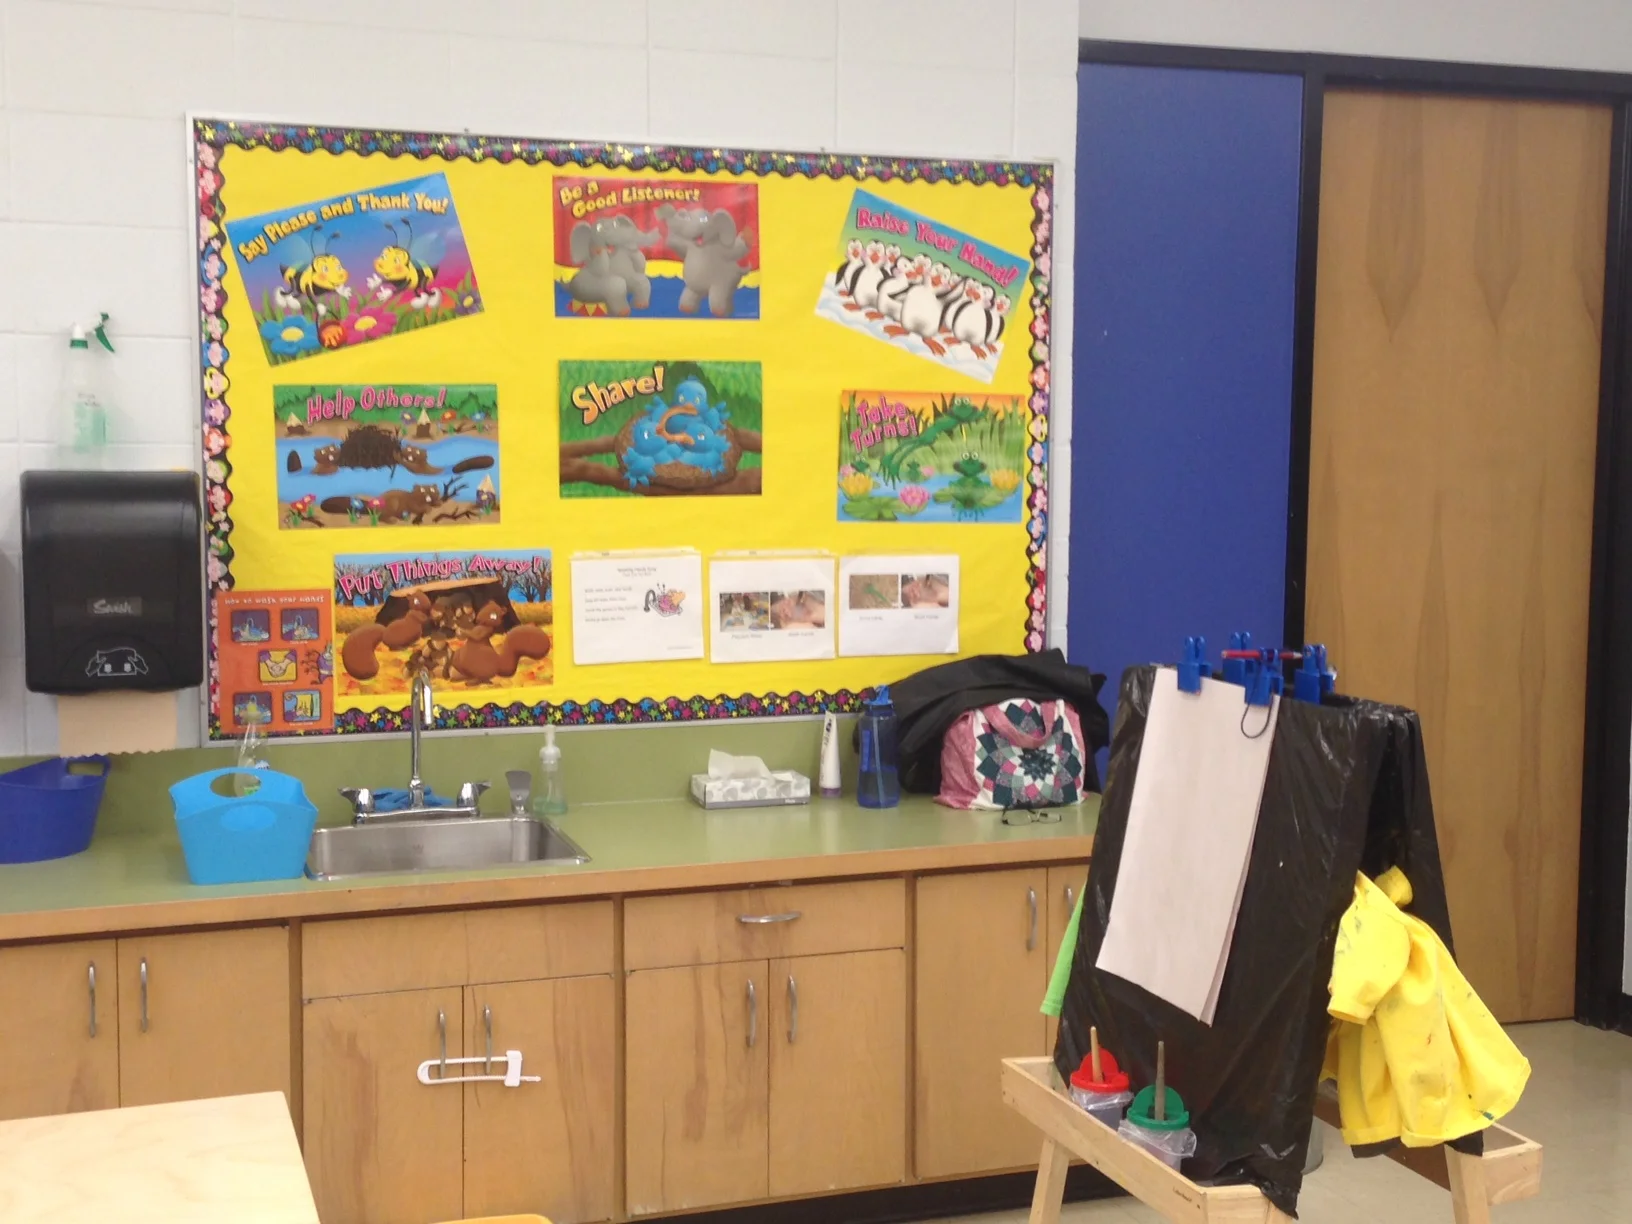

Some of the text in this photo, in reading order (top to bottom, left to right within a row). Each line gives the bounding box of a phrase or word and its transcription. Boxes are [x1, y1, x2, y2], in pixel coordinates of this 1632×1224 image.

[560, 180, 600, 207] Be a
[572, 186, 701, 219] Good Listener!
[238, 191, 449, 263] Say Please and Thank You!
[856, 206, 1020, 289] Raise Your Hand!
[306, 384, 448, 426] Help Others!
[571, 364, 665, 426] Share!
[856, 395, 907, 430] Take
[850, 414, 919, 454] Turns!
[338, 553, 542, 601] Put Things Away!
